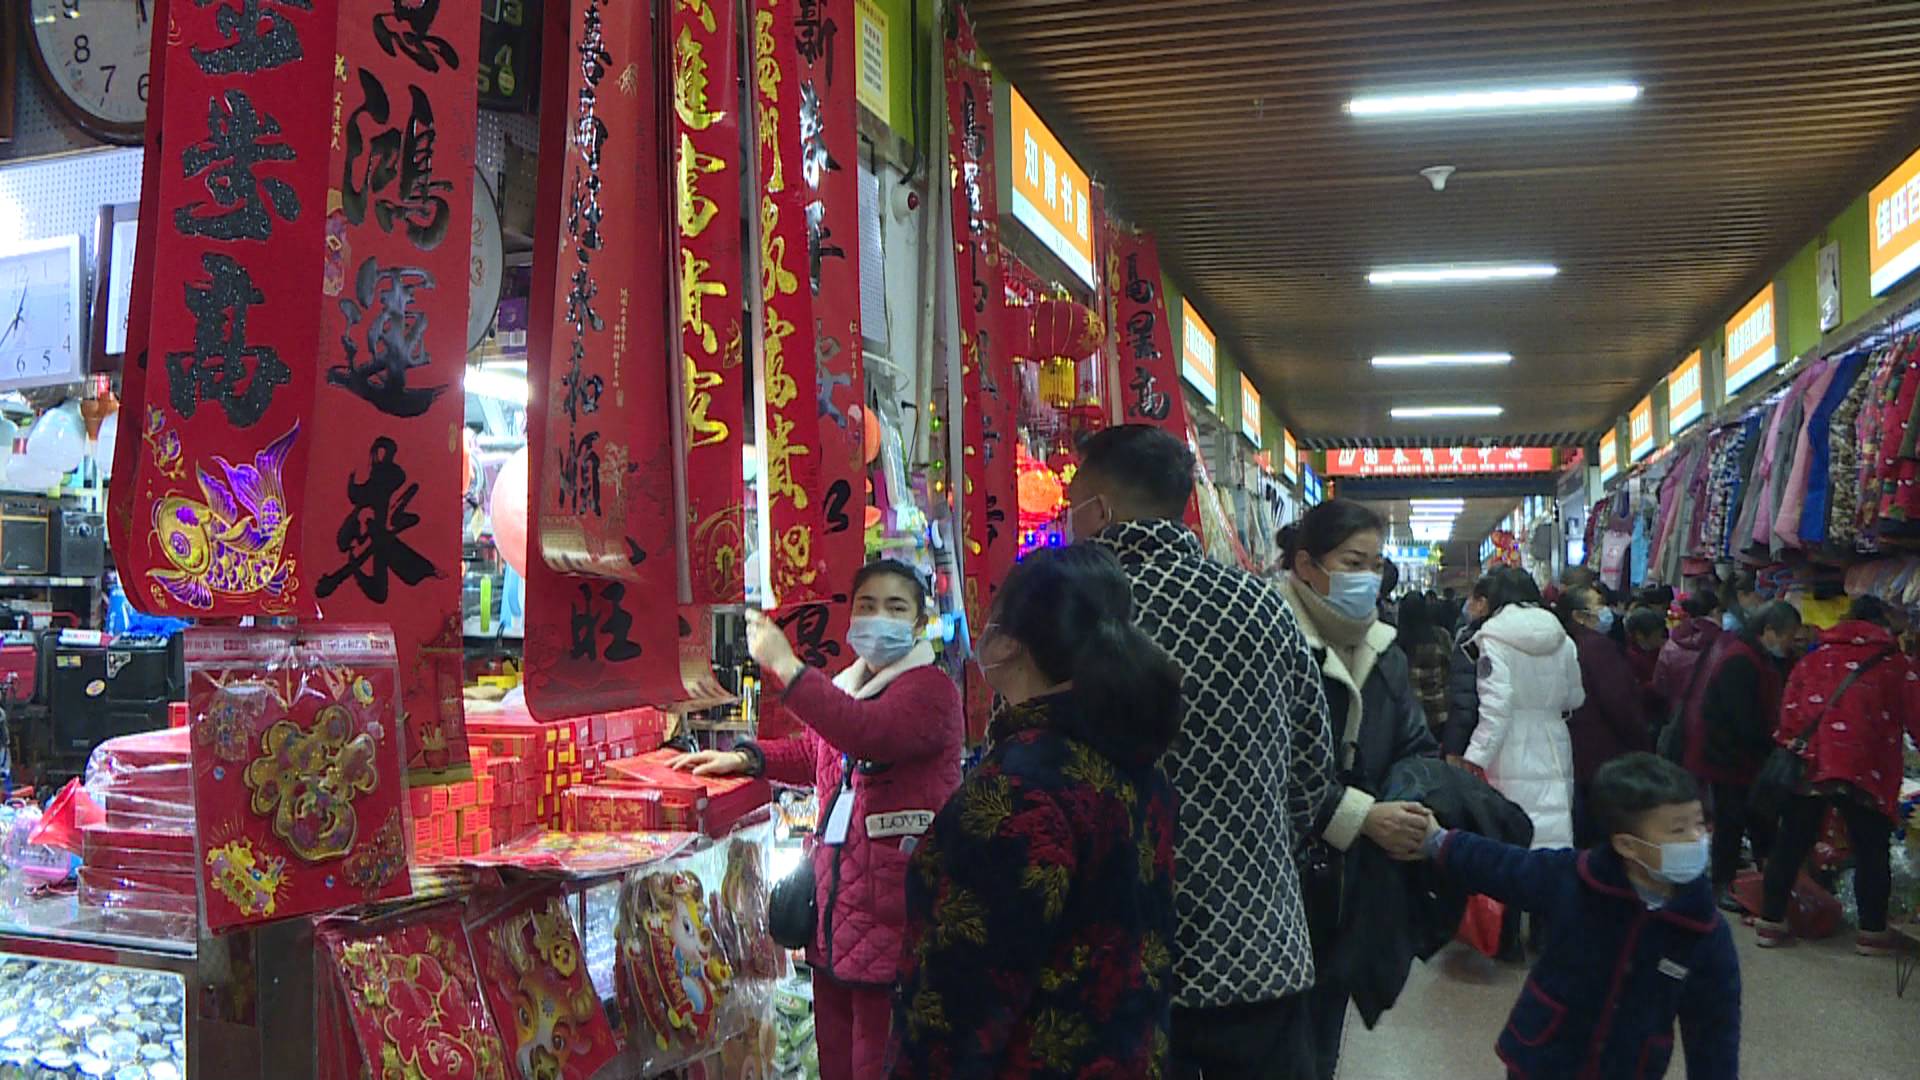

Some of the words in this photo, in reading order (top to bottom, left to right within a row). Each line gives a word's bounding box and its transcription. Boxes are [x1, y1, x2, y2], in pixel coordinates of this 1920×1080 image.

[74, 34, 90, 62] 8
[100, 65, 117, 93] 7
[137, 73, 151, 101] 6
[62, 335, 71, 352] 4
[16, 353, 26, 374] 6
[42, 350, 51, 371] 5
[877, 813, 930, 829] LOVE
